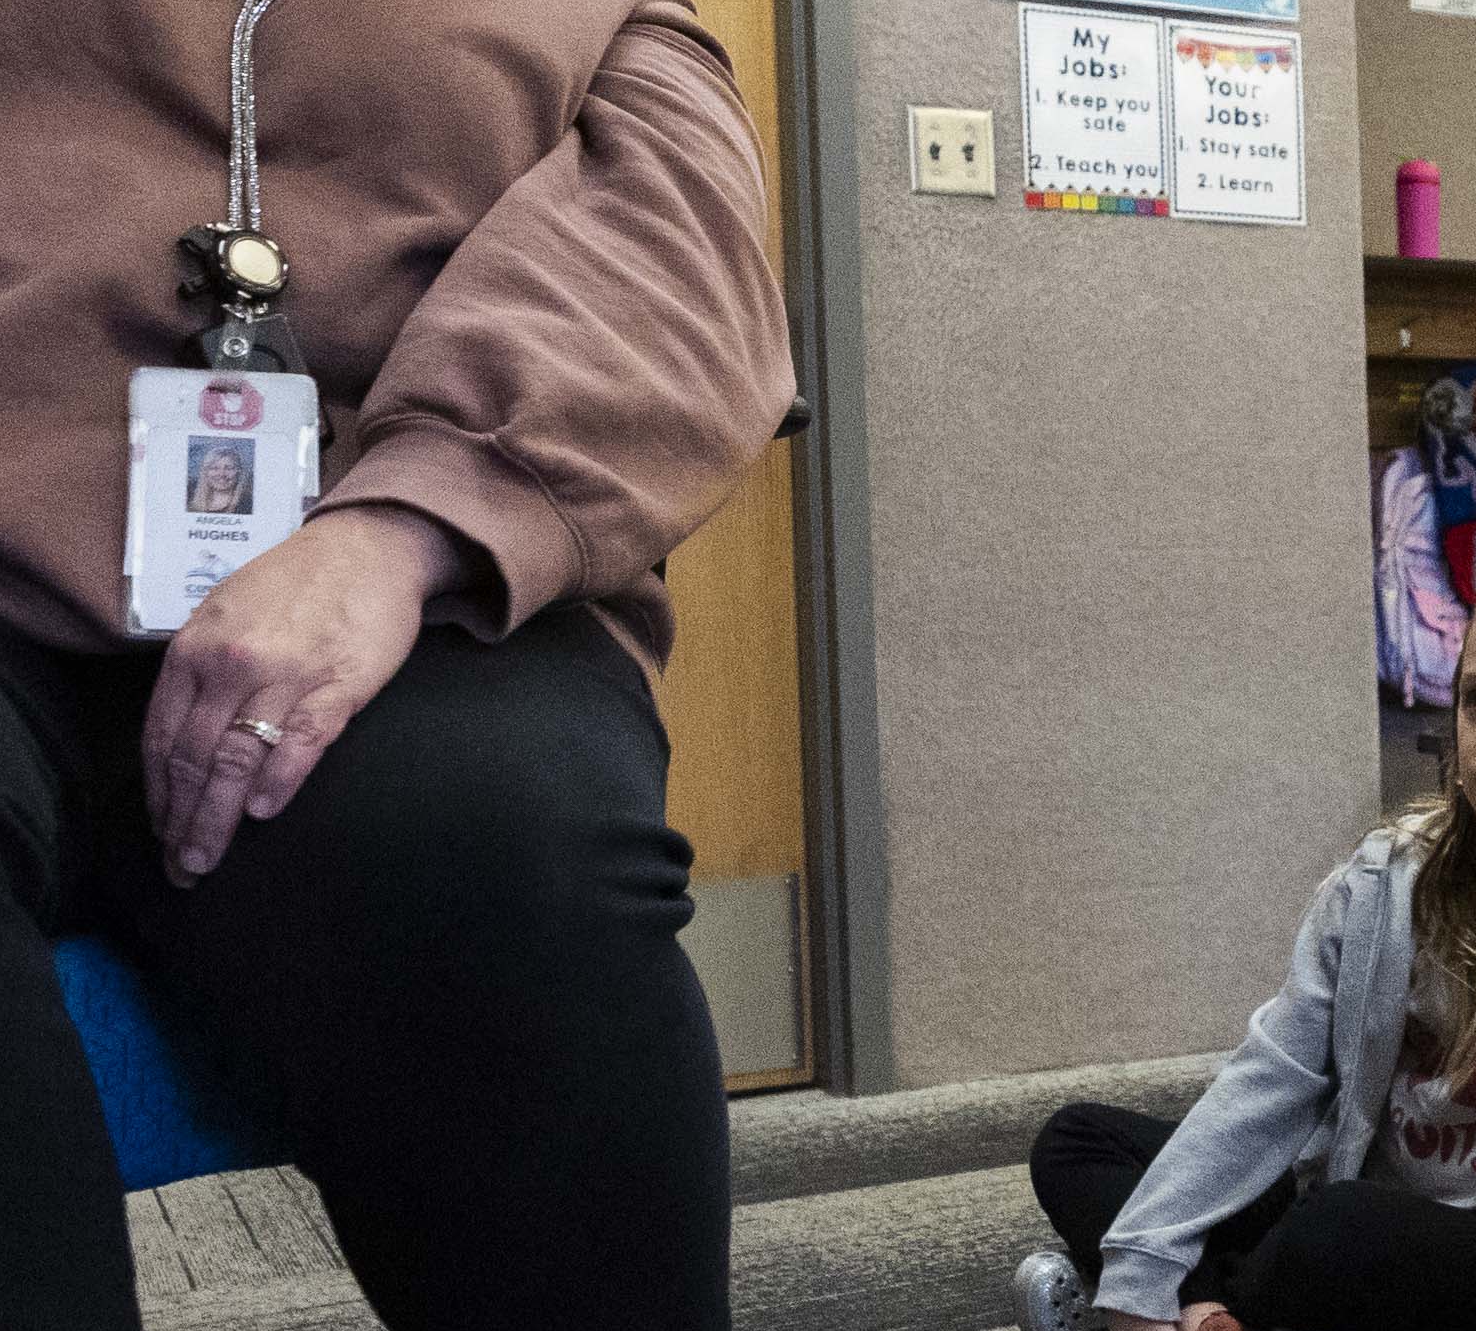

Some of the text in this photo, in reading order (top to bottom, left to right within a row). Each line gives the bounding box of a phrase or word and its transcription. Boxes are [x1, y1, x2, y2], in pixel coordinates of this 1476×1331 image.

[1073, 27, 1110, 54] My
[1059, 56, 1126, 80] Jobs:
[1206, 75, 1262, 100] Your
[1057, 91, 1107, 112] Keep
[1116, 96, 1151, 115] you
[1083, 115, 1126, 133] safe
[1206, 105, 1269, 128] Jobs:
[1200, 138, 1241, 159] Stay
[1249, 142, 1289, 160] safe
[1057, 155, 1116, 175] Teach
[1124, 162, 1159, 179] you
[1219, 175, 1274, 193] Learn
[213, 411, 248, 427] STOP
[187, 529, 250, 542] HUGHES
